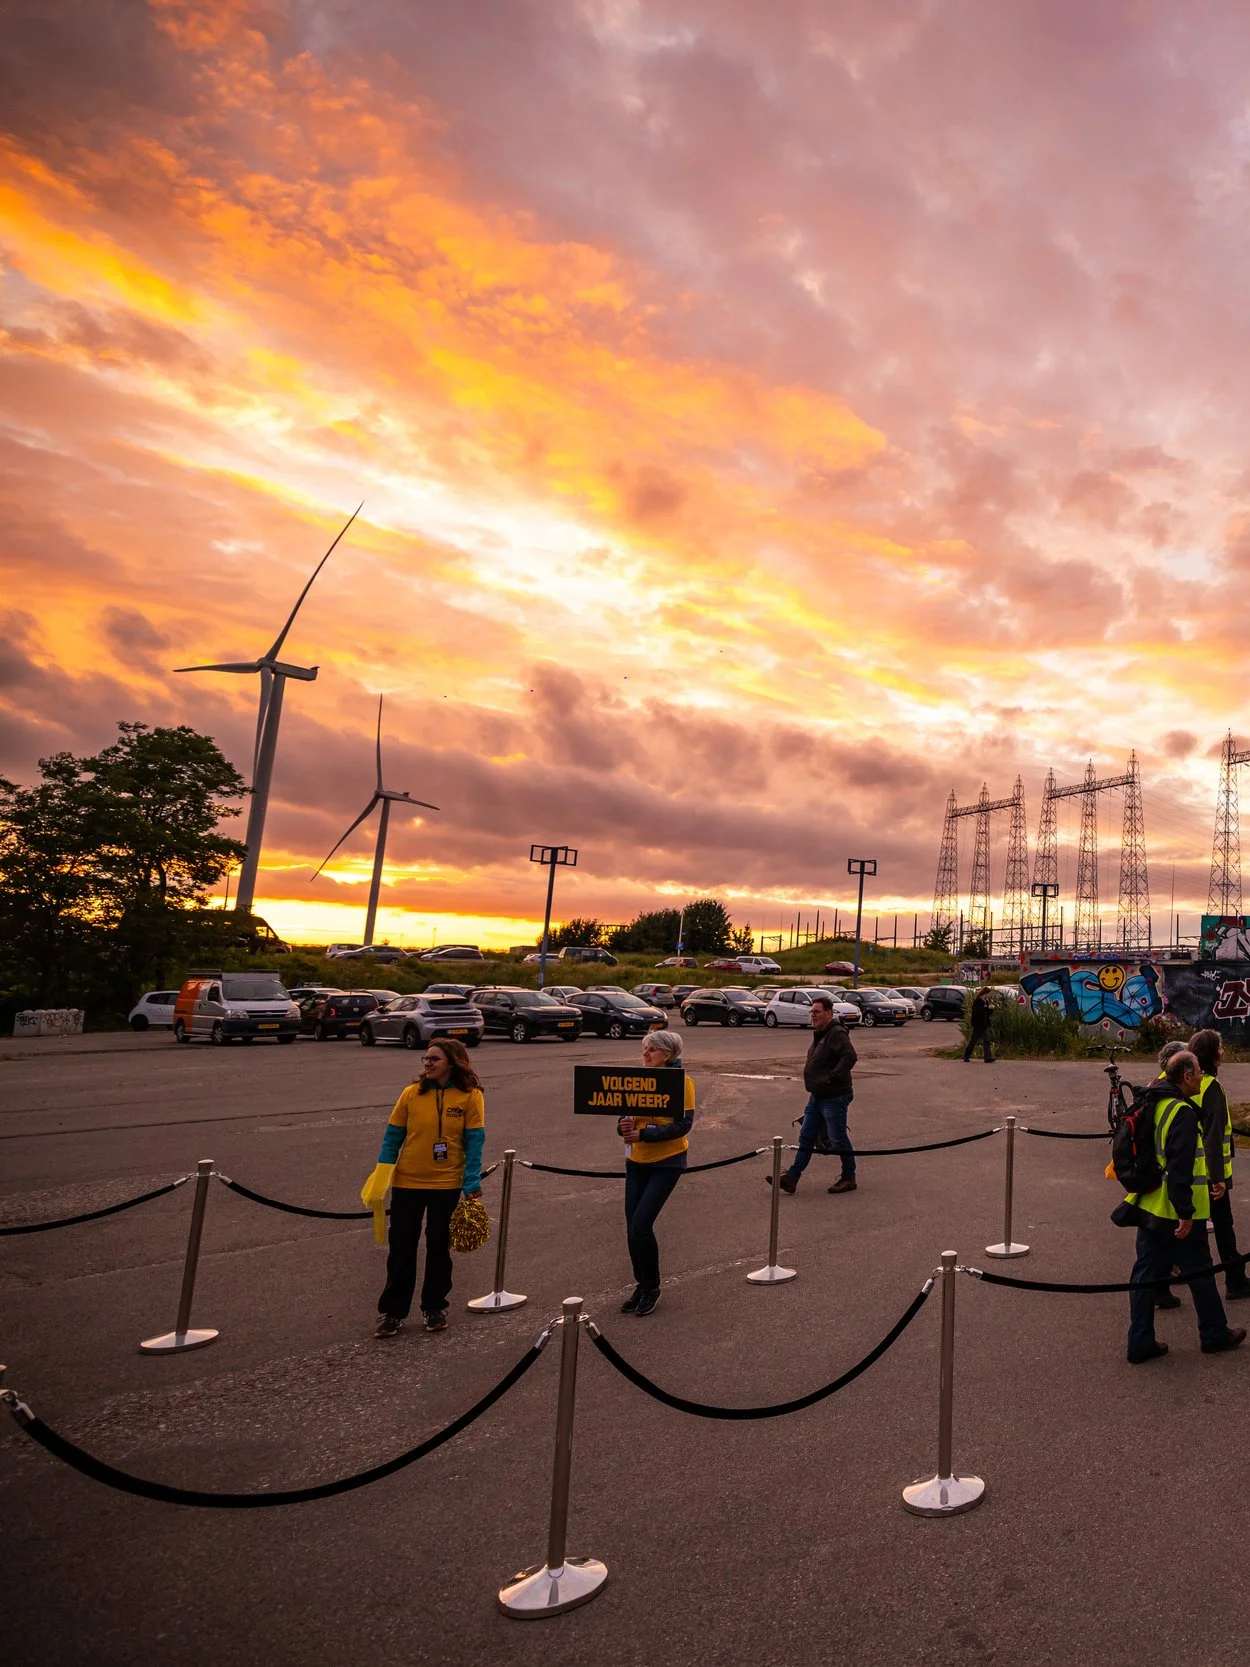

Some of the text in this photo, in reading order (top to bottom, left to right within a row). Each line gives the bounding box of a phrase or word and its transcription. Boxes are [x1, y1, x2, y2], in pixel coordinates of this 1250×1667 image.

[601, 1075, 657, 1092] VOLGEND
[588, 1091, 670, 1108] JAAR WEER?
